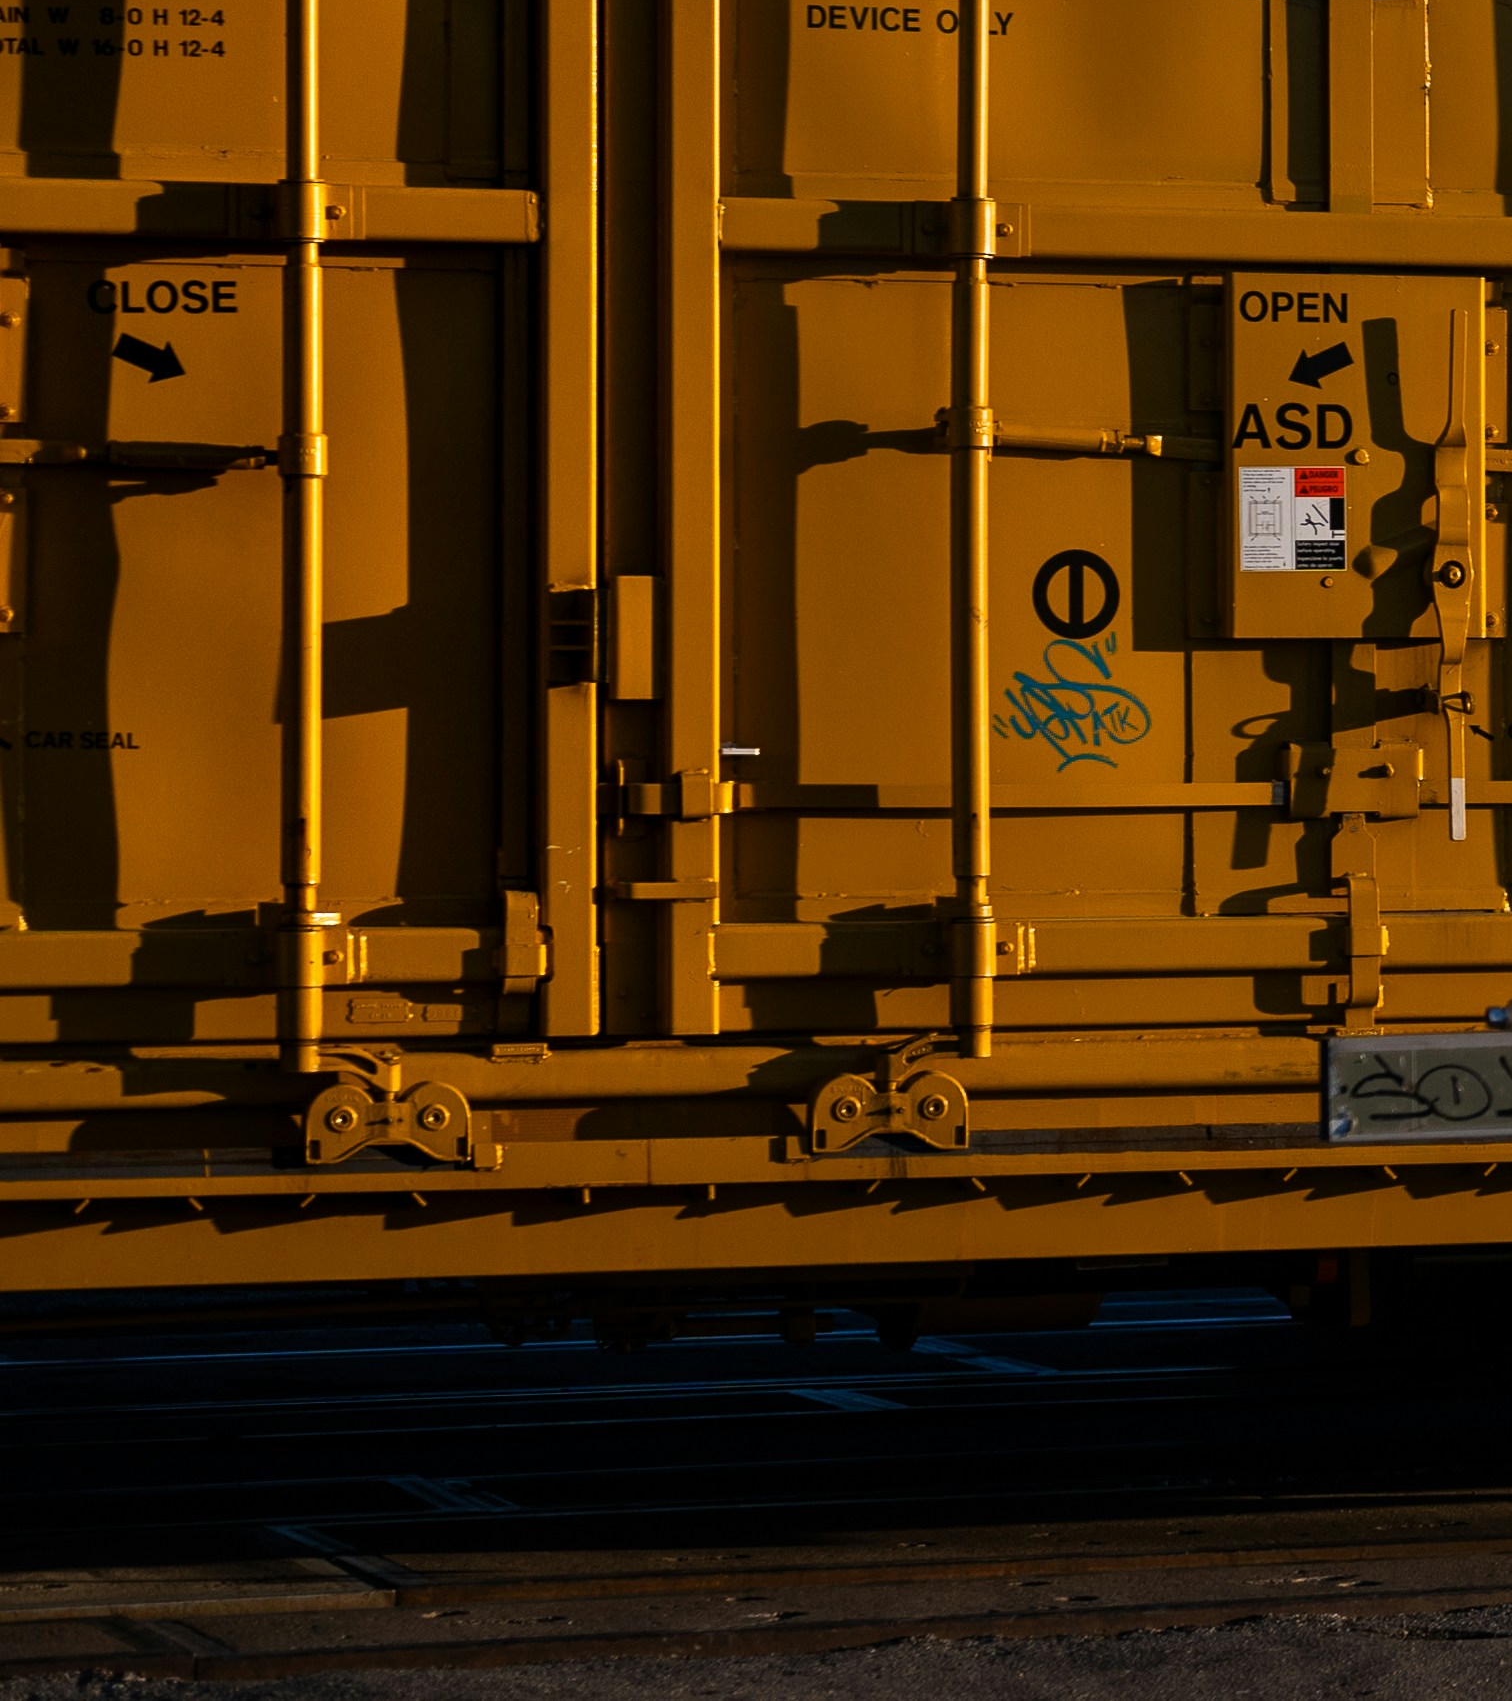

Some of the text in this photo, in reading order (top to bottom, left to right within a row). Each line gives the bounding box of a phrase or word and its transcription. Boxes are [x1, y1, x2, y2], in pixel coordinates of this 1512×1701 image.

[47, 7, 69, 23] W
[153, 8, 168, 25] H
[179, 9, 225, 26] 12-4
[806, 5, 1014, 35] DEVICE OY
[58, 39, 79, 55] W
[153, 40, 168, 56] H
[179, 40, 225, 57] 12-4
[87, 280, 238, 314] CLOSE
[1239, 291, 1348, 323] OPEN
[1232, 402, 1353, 450] ASD
[25, 731, 140, 750] CAR SEAL
